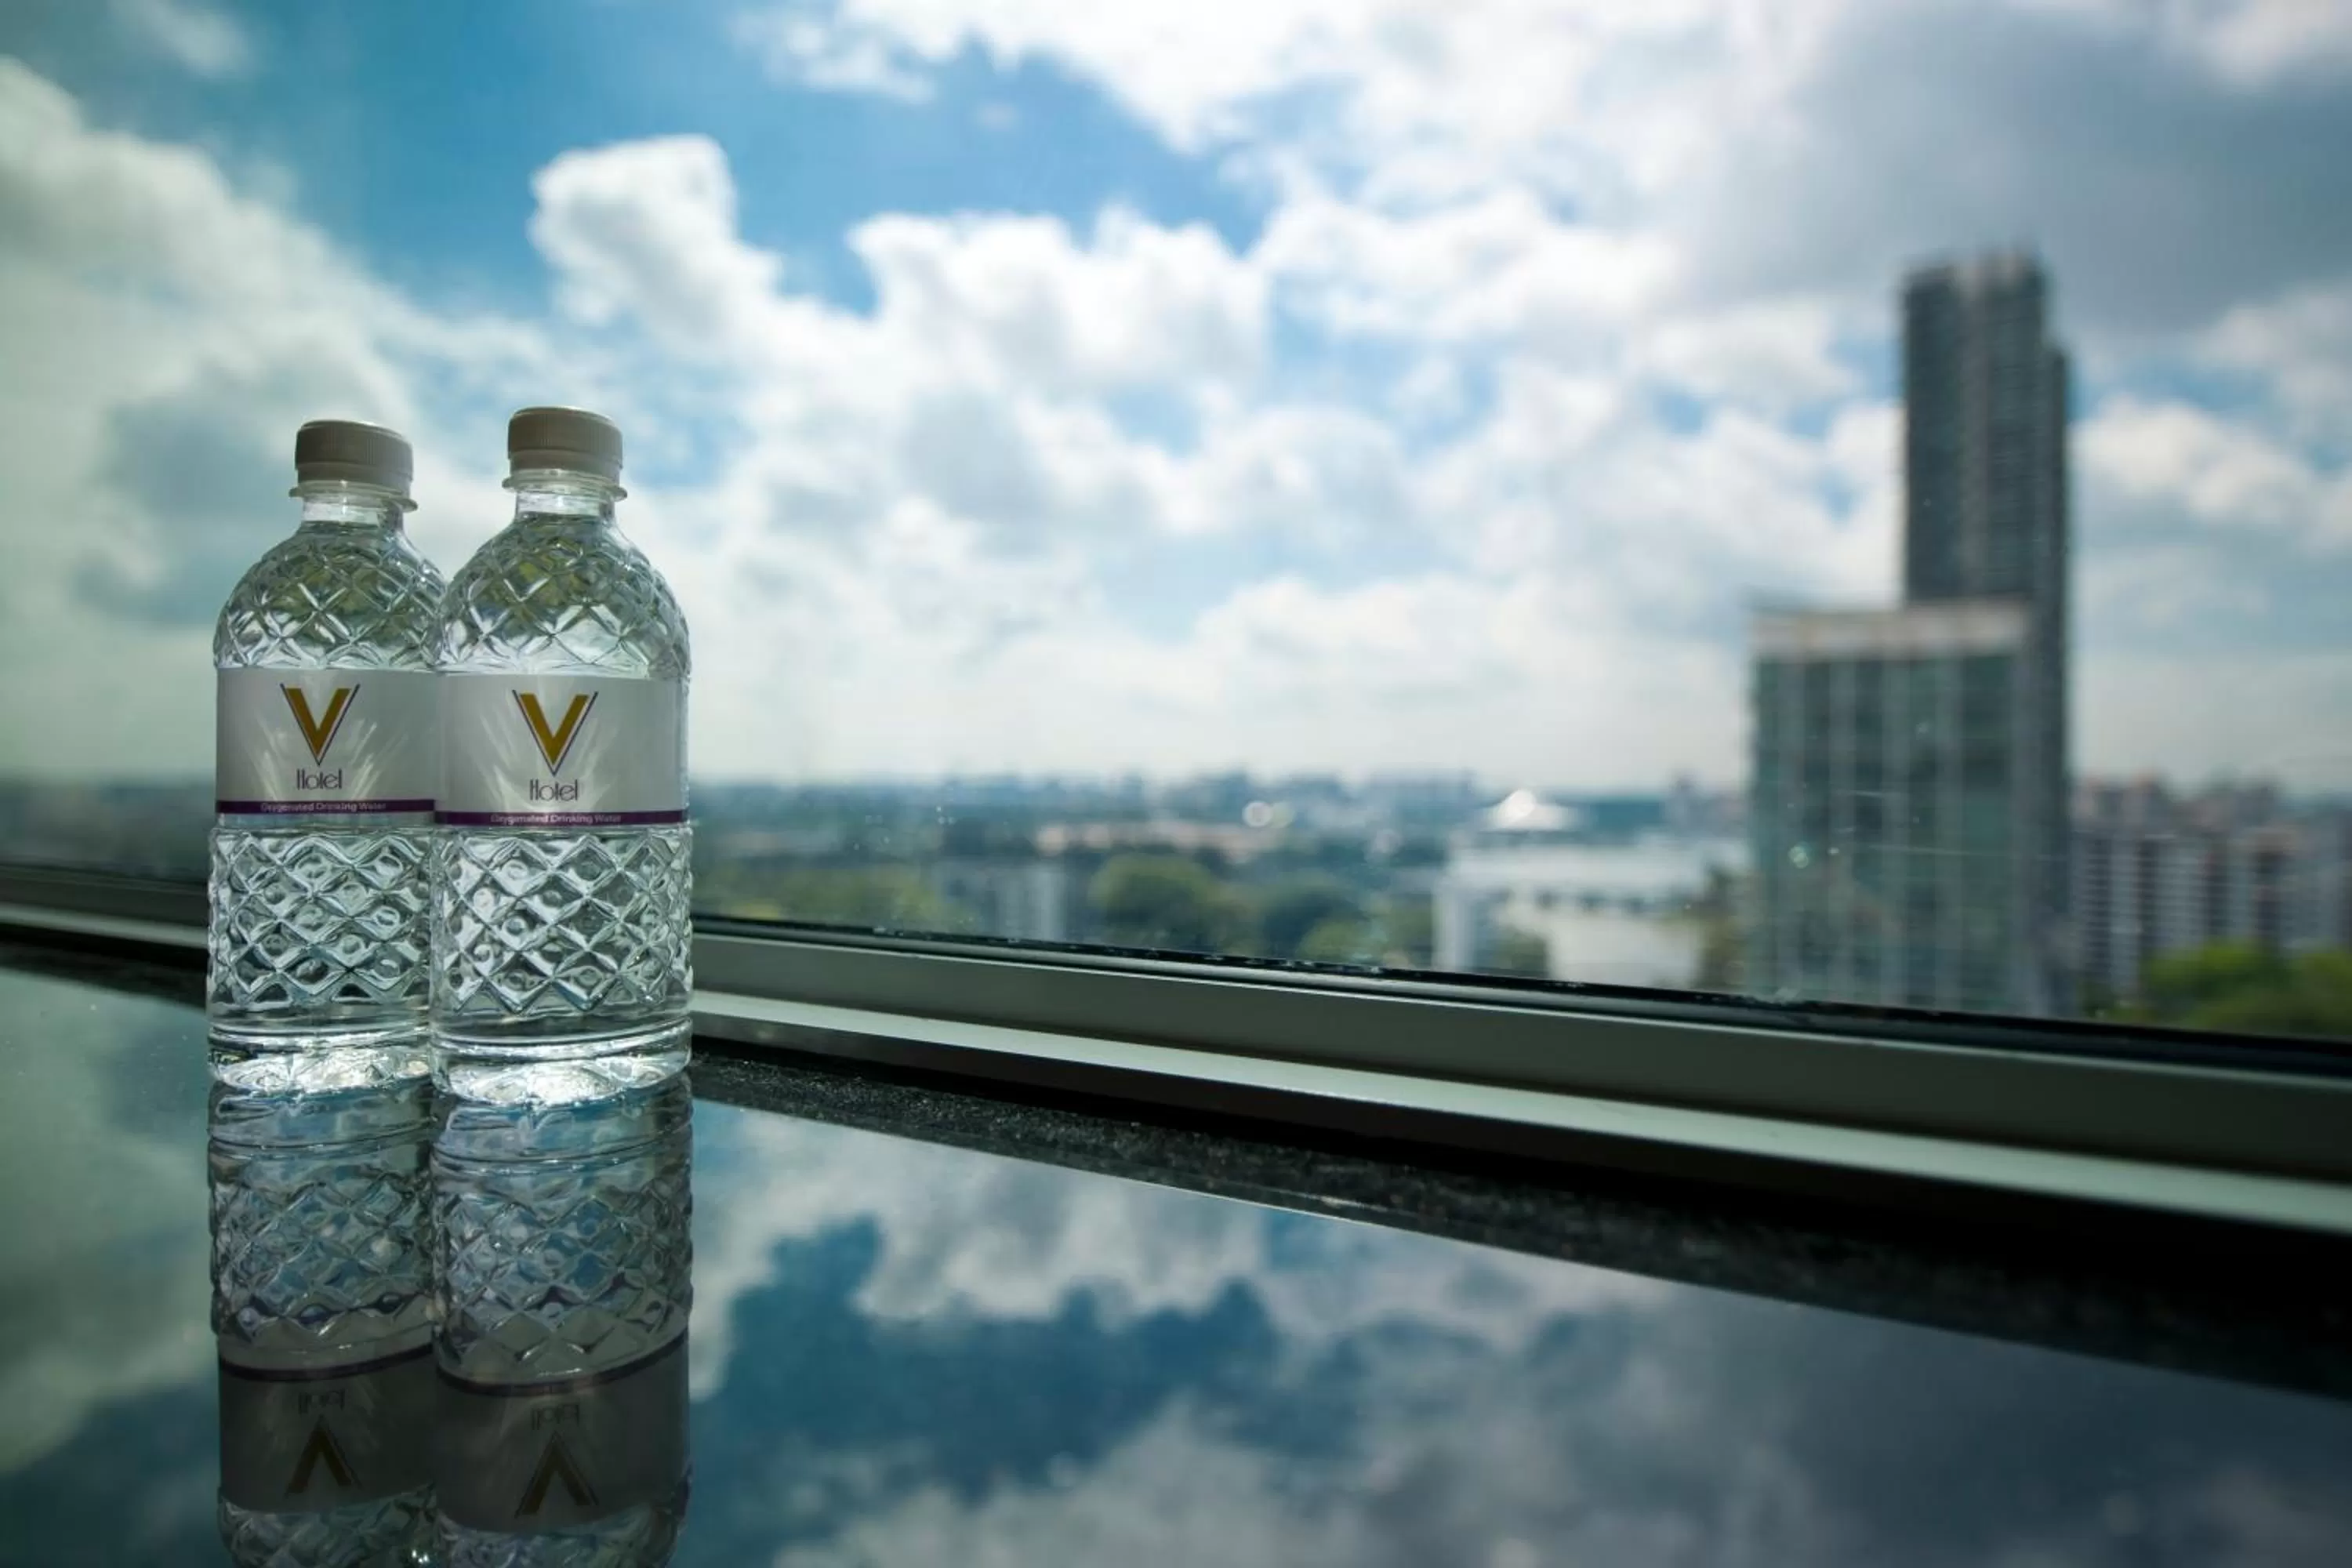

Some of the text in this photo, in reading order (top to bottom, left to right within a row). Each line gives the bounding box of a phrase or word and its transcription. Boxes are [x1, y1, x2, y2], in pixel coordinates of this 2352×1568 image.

[280, 683, 361, 766] V
[512, 689, 598, 777] V
[529, 779, 579, 800] Hotel
[316, 801, 357, 812] Drinking
[550, 814, 593, 824] Drinking
[594, 814, 621, 822] Water
